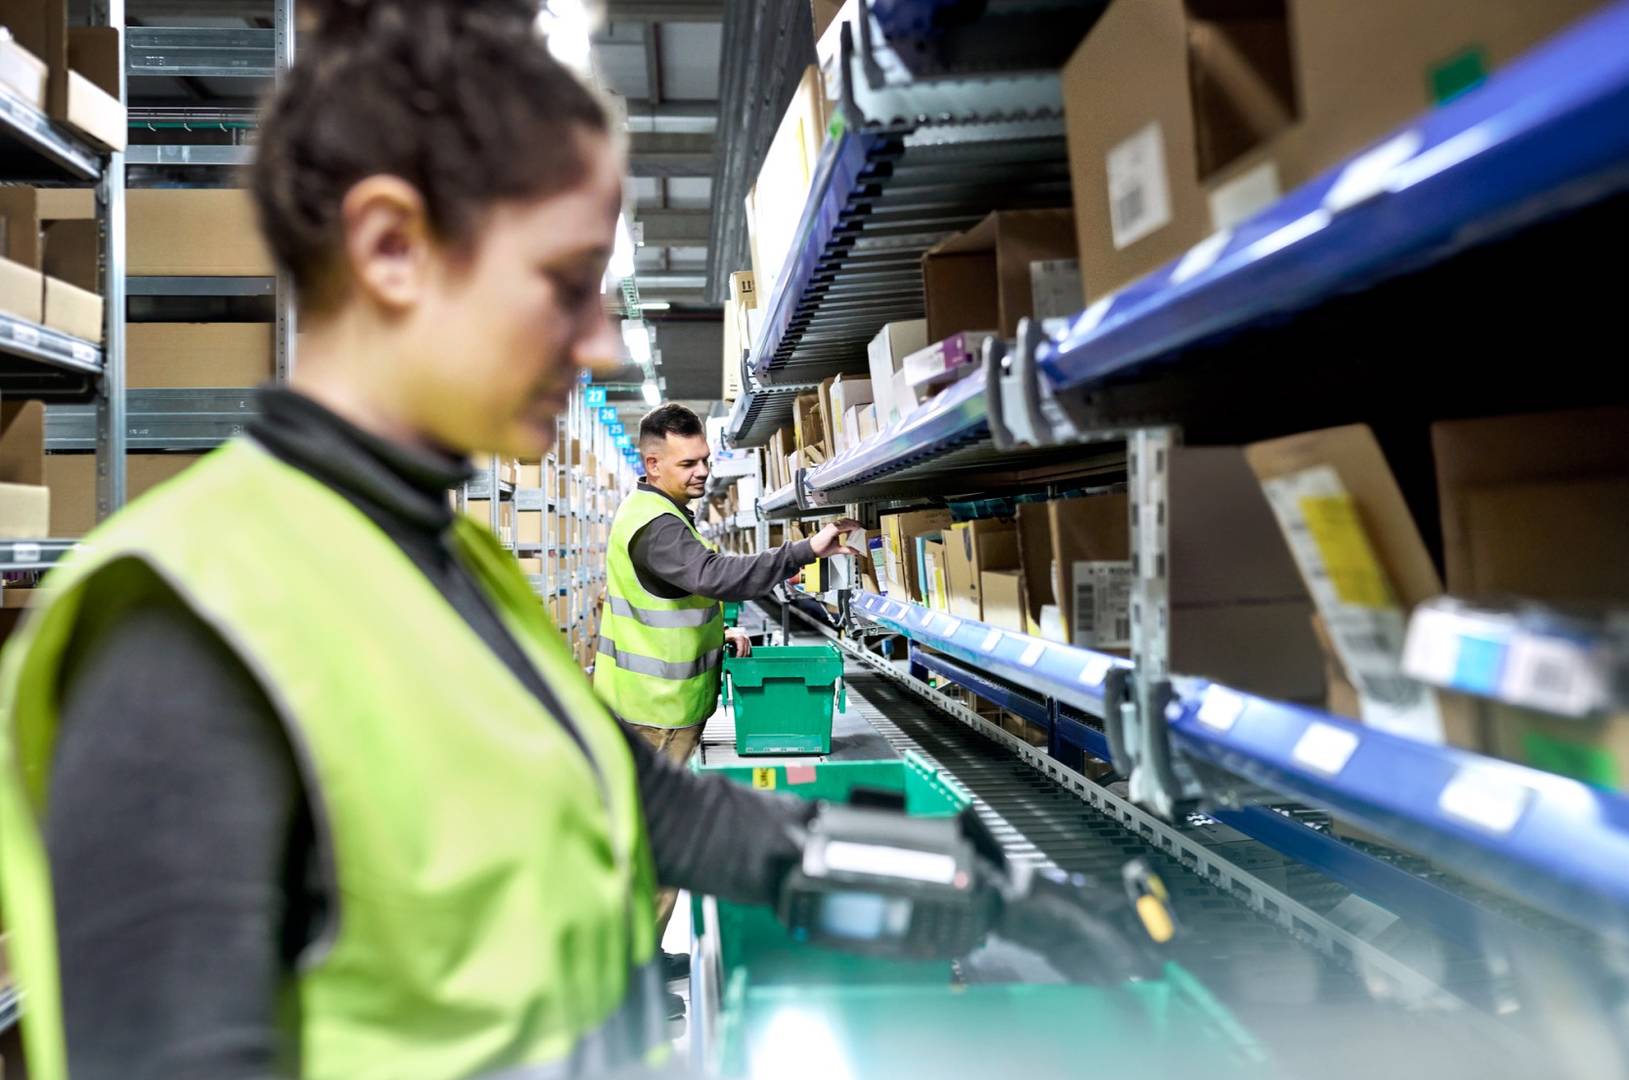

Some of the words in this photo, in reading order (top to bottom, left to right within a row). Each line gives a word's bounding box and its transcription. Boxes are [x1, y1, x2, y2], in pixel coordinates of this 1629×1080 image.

[588, 390, 603, 403] 27
[601, 409, 615, 420] 26
[611, 426, 622, 434] 25
